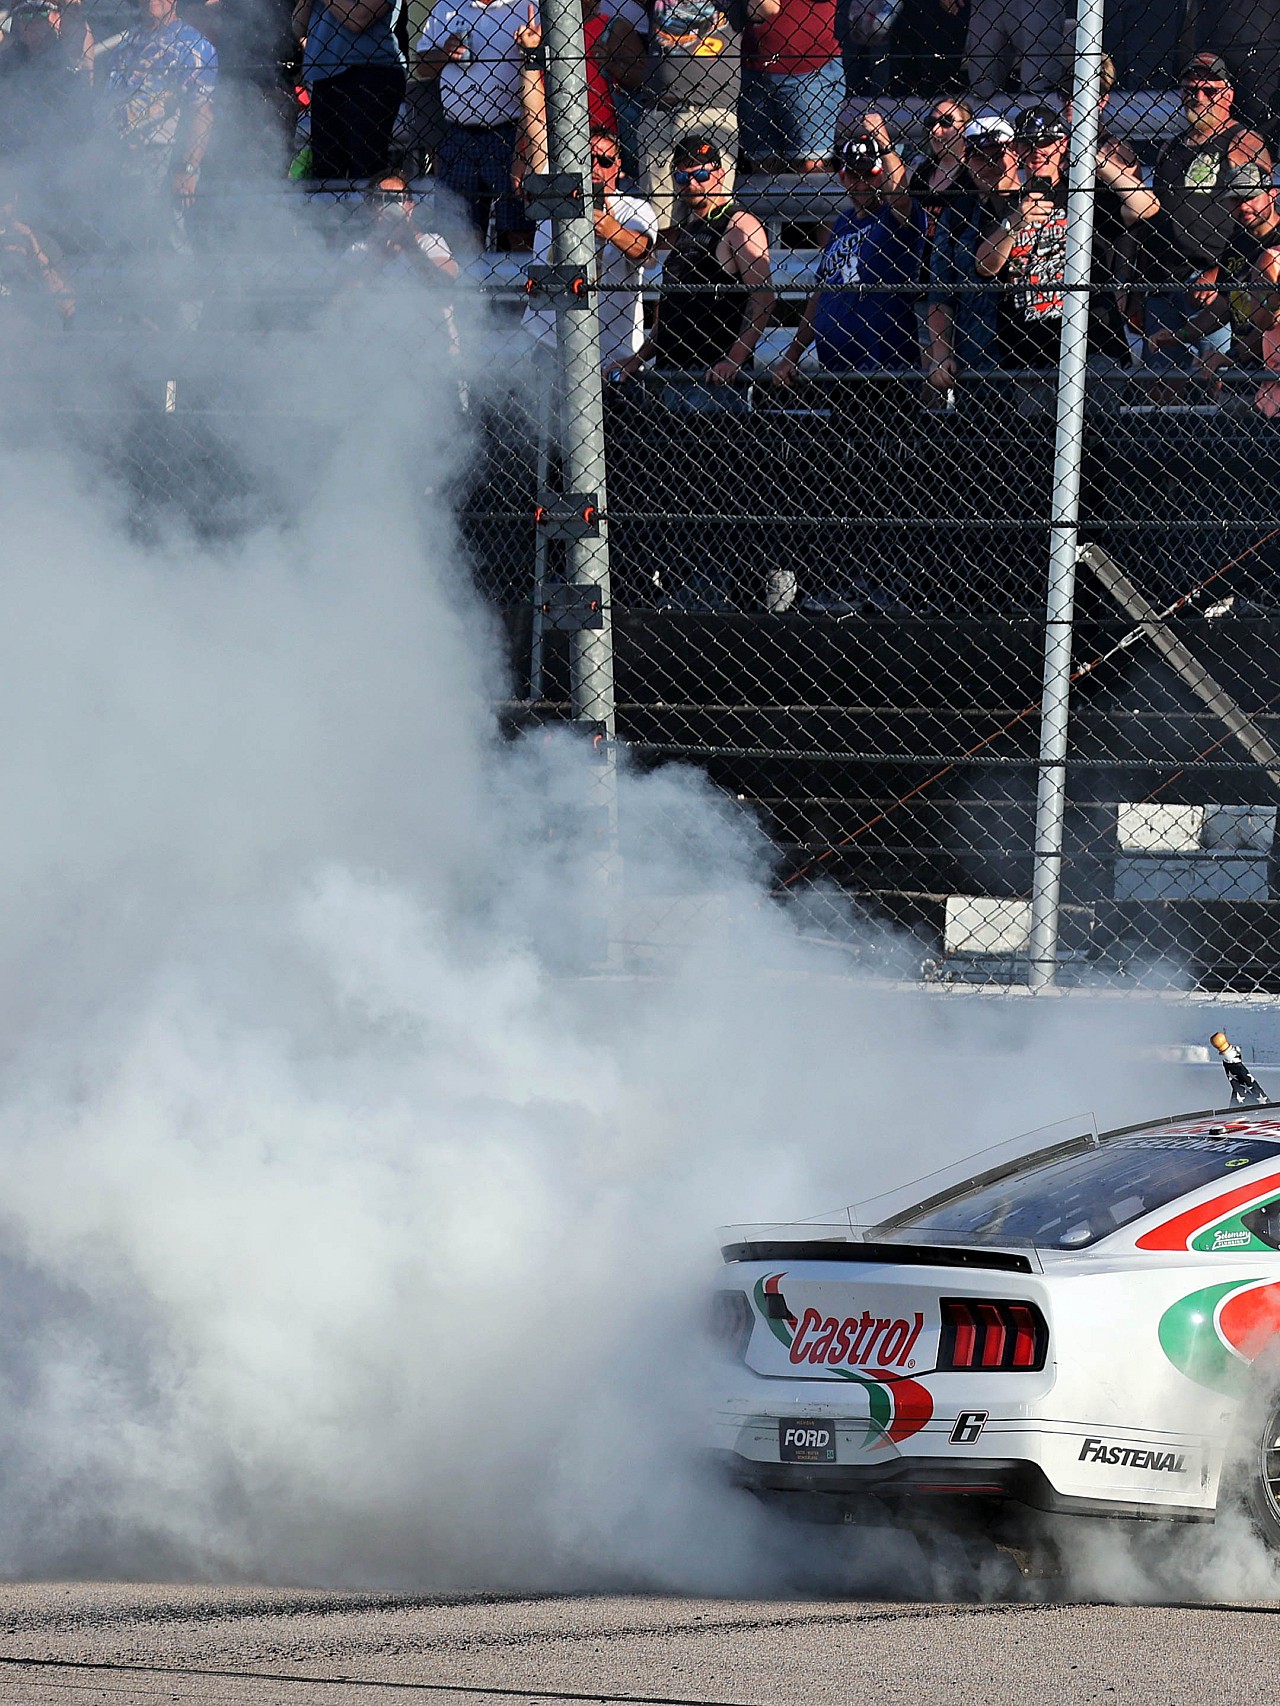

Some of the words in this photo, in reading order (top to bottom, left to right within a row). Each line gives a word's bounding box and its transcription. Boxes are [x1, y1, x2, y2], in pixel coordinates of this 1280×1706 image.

[789, 1307, 924, 1367] Castrol
[784, 1428, 830, 1447] FORD
[948, 1409, 989, 1445] 6
